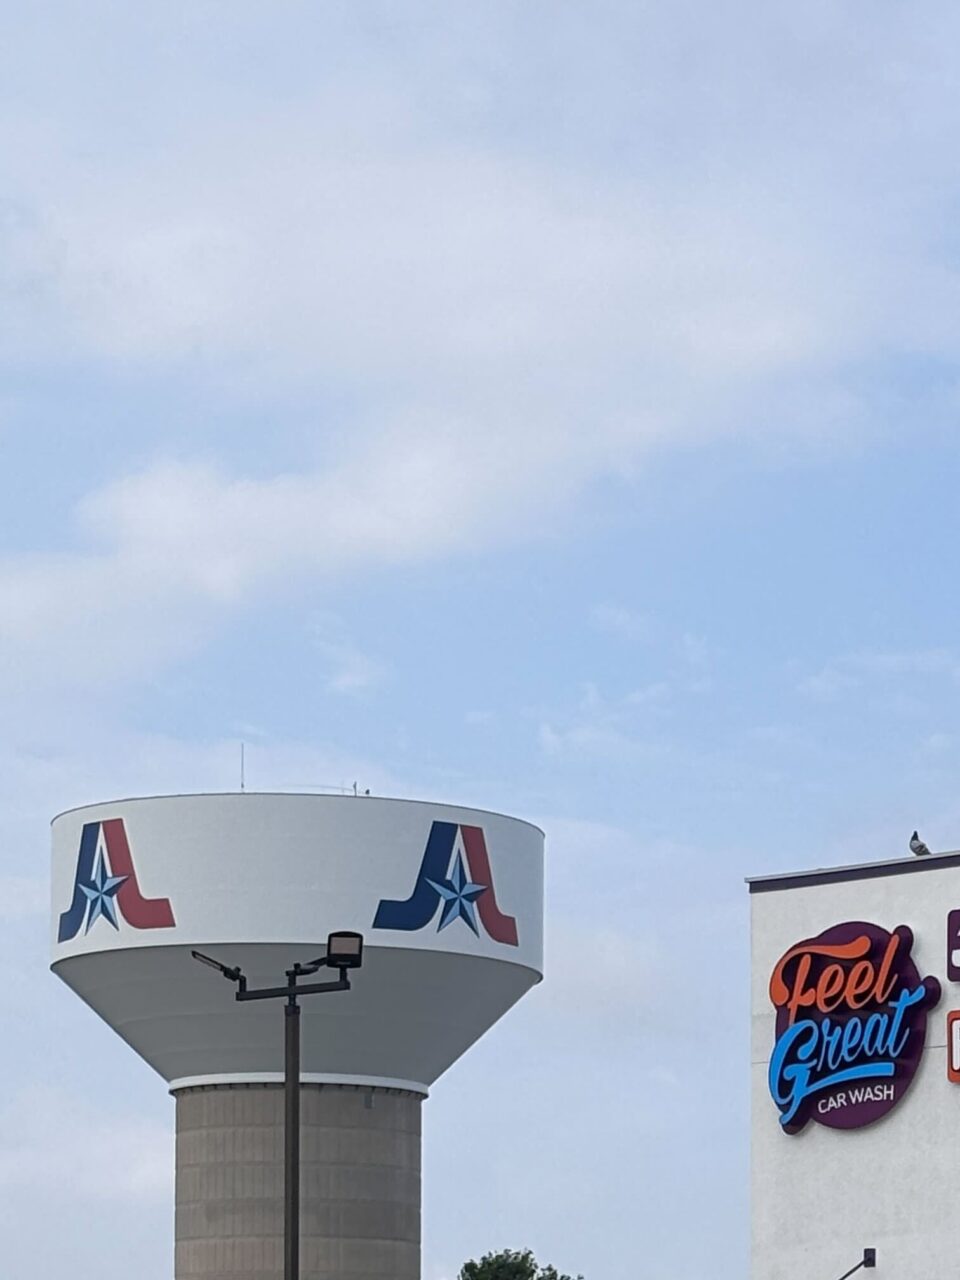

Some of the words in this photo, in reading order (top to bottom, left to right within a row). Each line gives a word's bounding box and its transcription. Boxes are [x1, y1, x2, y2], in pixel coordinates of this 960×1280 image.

[770, 935, 900, 1025] Feel
[769, 985, 926, 1126] Great
[818, 1092, 848, 1115] CAR
[848, 1084, 895, 1105] WASH
